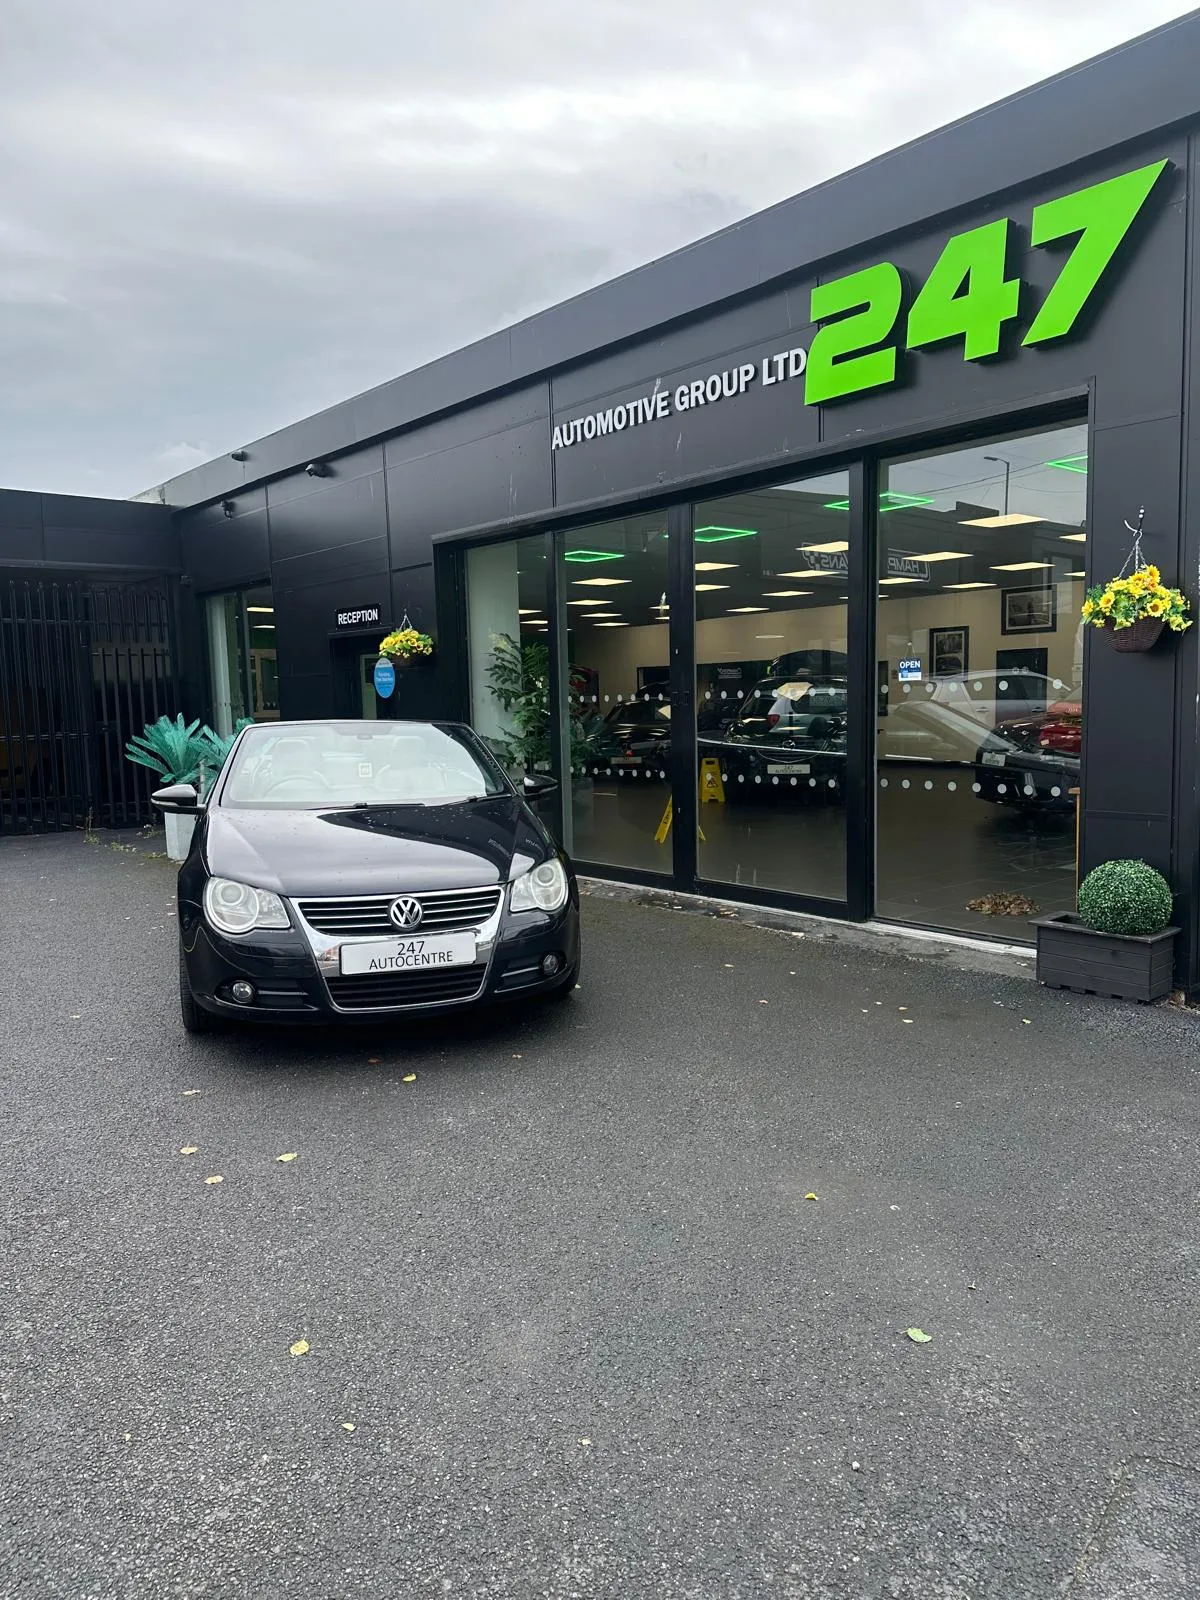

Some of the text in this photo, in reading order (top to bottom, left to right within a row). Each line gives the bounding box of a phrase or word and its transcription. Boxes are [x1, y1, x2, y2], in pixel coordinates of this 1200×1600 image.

[804, 158, 1169, 406] 247
[551, 347, 807, 450] AUTOMOTIVE GROUP LTD
[338, 609, 378, 624] RECEPTION
[899, 660, 921, 669] OPEN
[398, 940, 425, 956] 247
[369, 951, 453, 969] AUTOCENTRE
